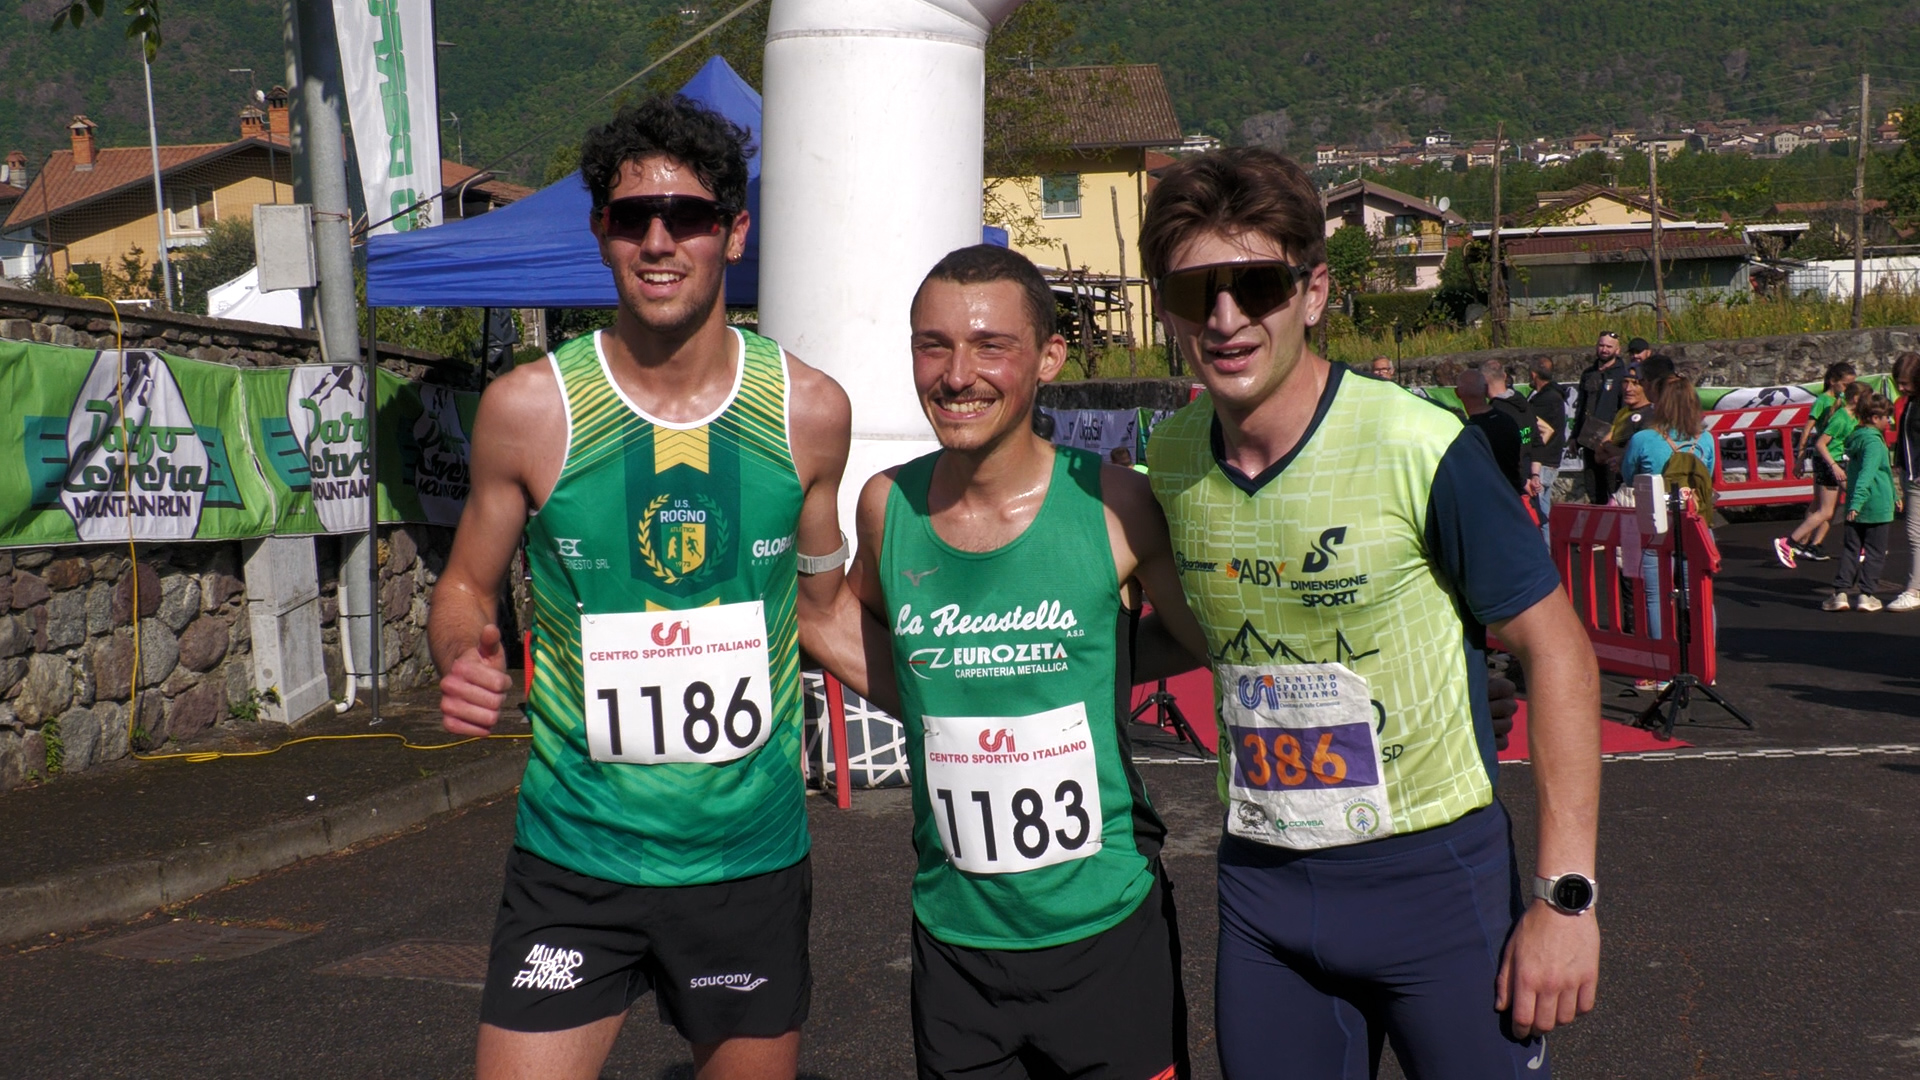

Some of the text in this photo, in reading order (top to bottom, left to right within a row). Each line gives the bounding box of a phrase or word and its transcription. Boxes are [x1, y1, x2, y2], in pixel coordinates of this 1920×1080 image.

[157, 495, 191, 517] RUN
[674, 499, 691, 508] U.S.
[660, 509, 706, 523] ROGNO
[595, 558, 611, 570] SRL
[1290, 573, 1369, 591] DIMENSIONE
[1301, 589, 1359, 608] SPORT
[895, 599, 1078, 638] La Recastello
[589, 638, 761, 662] CENTRO SPORTIVO ITALIANO
[953, 642, 1068, 666] EUROZETA
[955, 661, 1069, 679] CARPENTERIA METALLICA
[1275, 673, 1336, 683] CENTRO
[1276, 681, 1337, 692] SPORTIVO
[1277, 689, 1339, 700] ITALIANO
[597, 676, 762, 756] 1186
[929, 740, 1087, 765] CENTRO SPORTIVO ITALIANO
[1243, 731, 1348, 787] 386
[936, 779, 1091, 862] 1183
[525, 943, 583, 968] MILANO
[530, 959, 575, 978] TRACK
[690, 972, 752, 989] saucony
